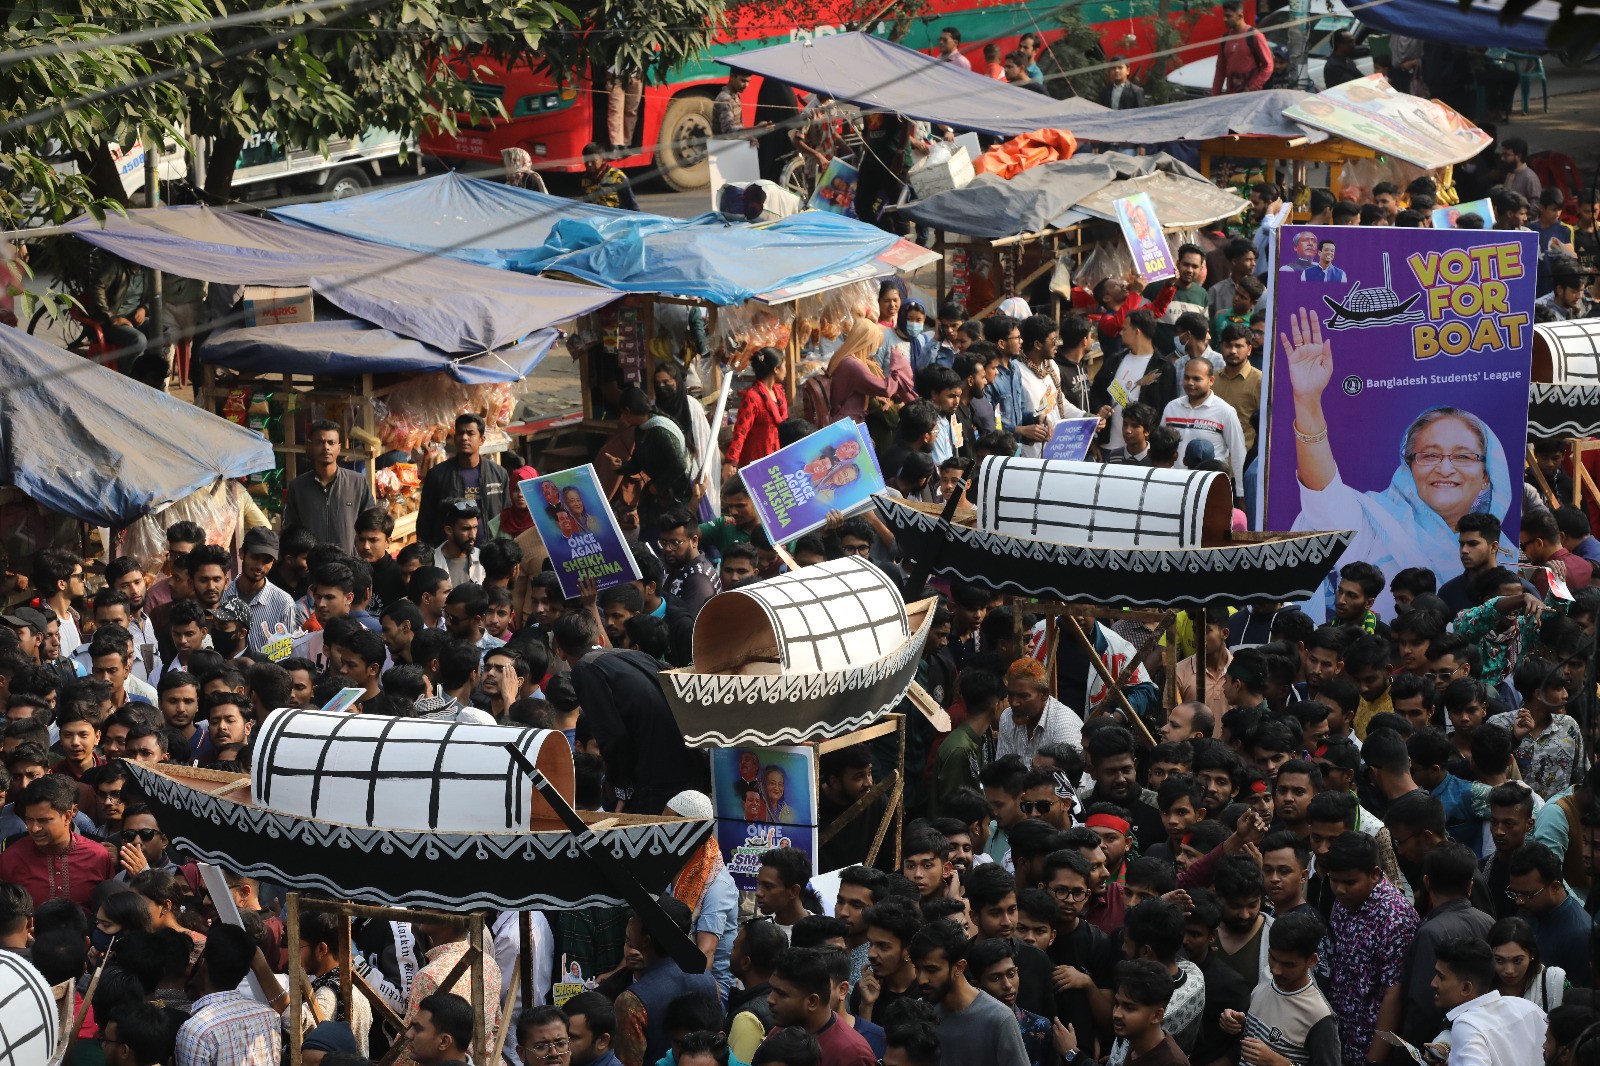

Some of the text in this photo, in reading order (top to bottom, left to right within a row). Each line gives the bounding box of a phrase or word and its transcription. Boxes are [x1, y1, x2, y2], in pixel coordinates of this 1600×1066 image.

[1144, 257, 1167, 274] BOAT
[1408, 242, 1524, 289] VOTE
[1427, 280, 1509, 322] FOR
[1412, 312, 1529, 361] BOAT
[1366, 370, 1522, 390] Bangladesh Students' League
[1064, 426, 1082, 434] MOVE
[1050, 443, 1065, 451] AND
[1053, 451, 1074, 459] SMART
[768, 465, 797, 509] SHEIKH
[784, 473, 808, 507] AGAIN
[795, 469, 816, 500] ONCE
[762, 480, 792, 528] HASINA
[568, 532, 596, 548] ONCE
[571, 542, 602, 559] AGAIN
[562, 552, 605, 573] SHEIKH
[577, 560, 623, 581] HASINA
